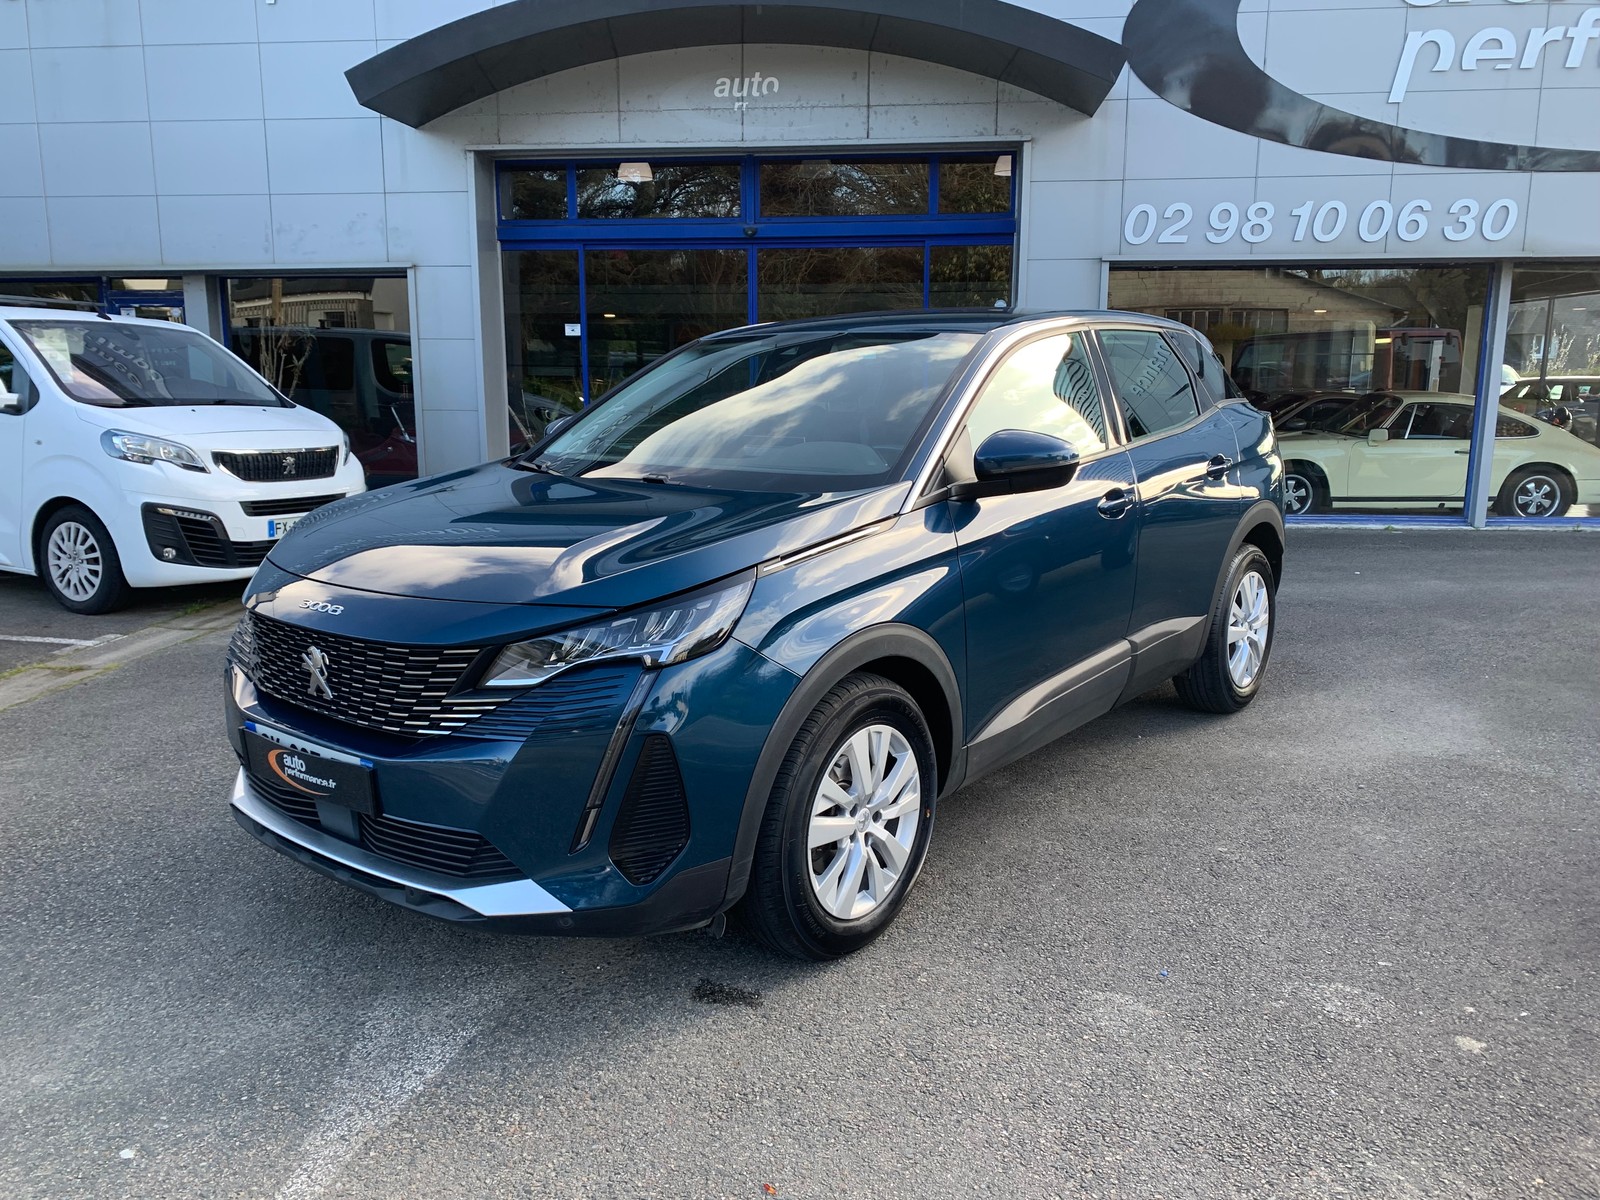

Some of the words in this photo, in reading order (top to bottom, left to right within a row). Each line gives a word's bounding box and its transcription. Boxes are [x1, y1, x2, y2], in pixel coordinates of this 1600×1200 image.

[1388, 7, 1600, 103] perf
[713, 72, 779, 97] auto
[1124, 202, 1193, 245] 02
[1205, 201, 1275, 244] 98
[1290, 200, 1347, 243] 10
[1358, 199, 1433, 242] 06
[1443, 198, 1518, 242] 30
[299, 599, 344, 615] 3008
[283, 754, 306, 772] auto
